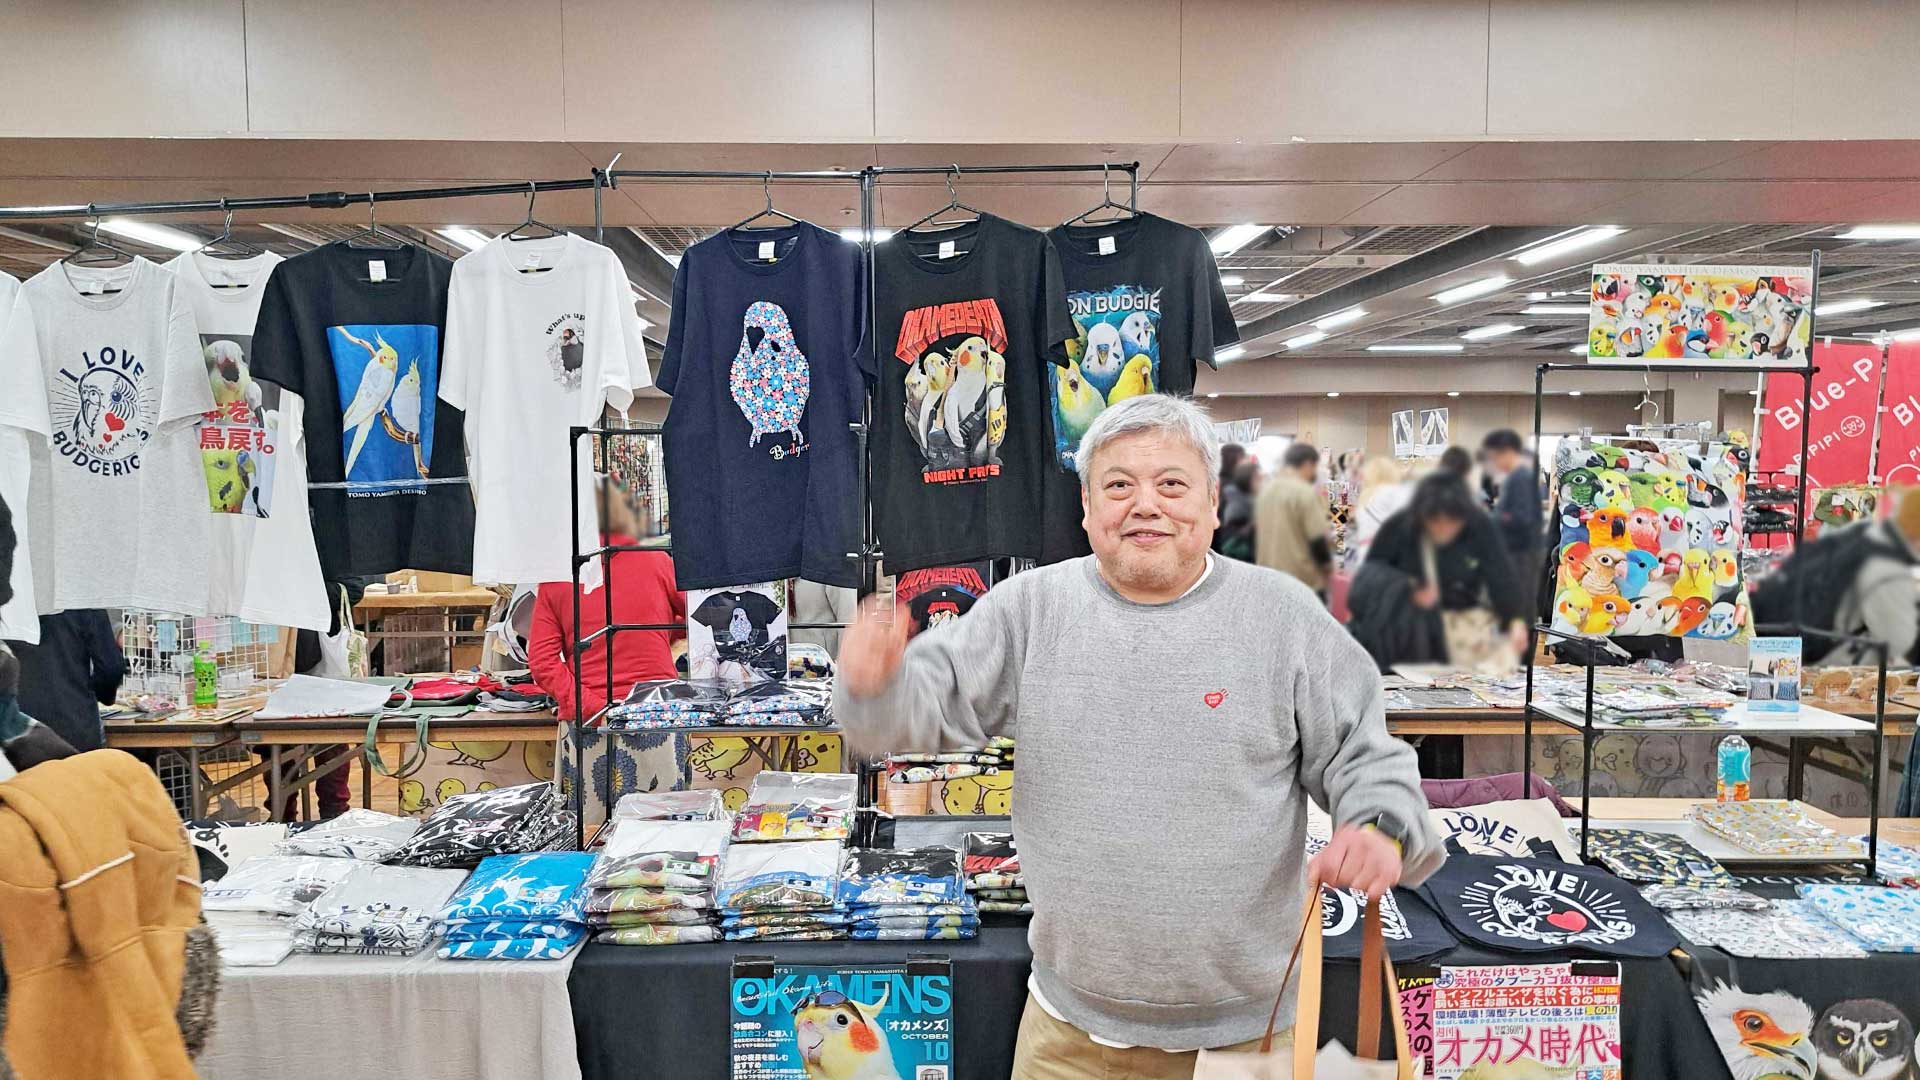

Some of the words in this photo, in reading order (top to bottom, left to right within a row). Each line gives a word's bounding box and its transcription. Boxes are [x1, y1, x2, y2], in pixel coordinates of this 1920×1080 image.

[1095, 287, 1163, 315] BUDGIE
[59, 367, 80, 384] I
[82, 346, 145, 382] LOVE
[1774, 357, 1874, 431] Blue-P
[923, 467, 966, 484] NIGHT
[348, 491, 371, 499] TOMO
[1443, 813, 1519, 844] LOVE
[1493, 868, 1579, 894] LOVE
[732, 974, 951, 1016] OKAMENS
[923, 1041, 949, 1061] 10
[1438, 1023, 1608, 1066] オカメ時代
